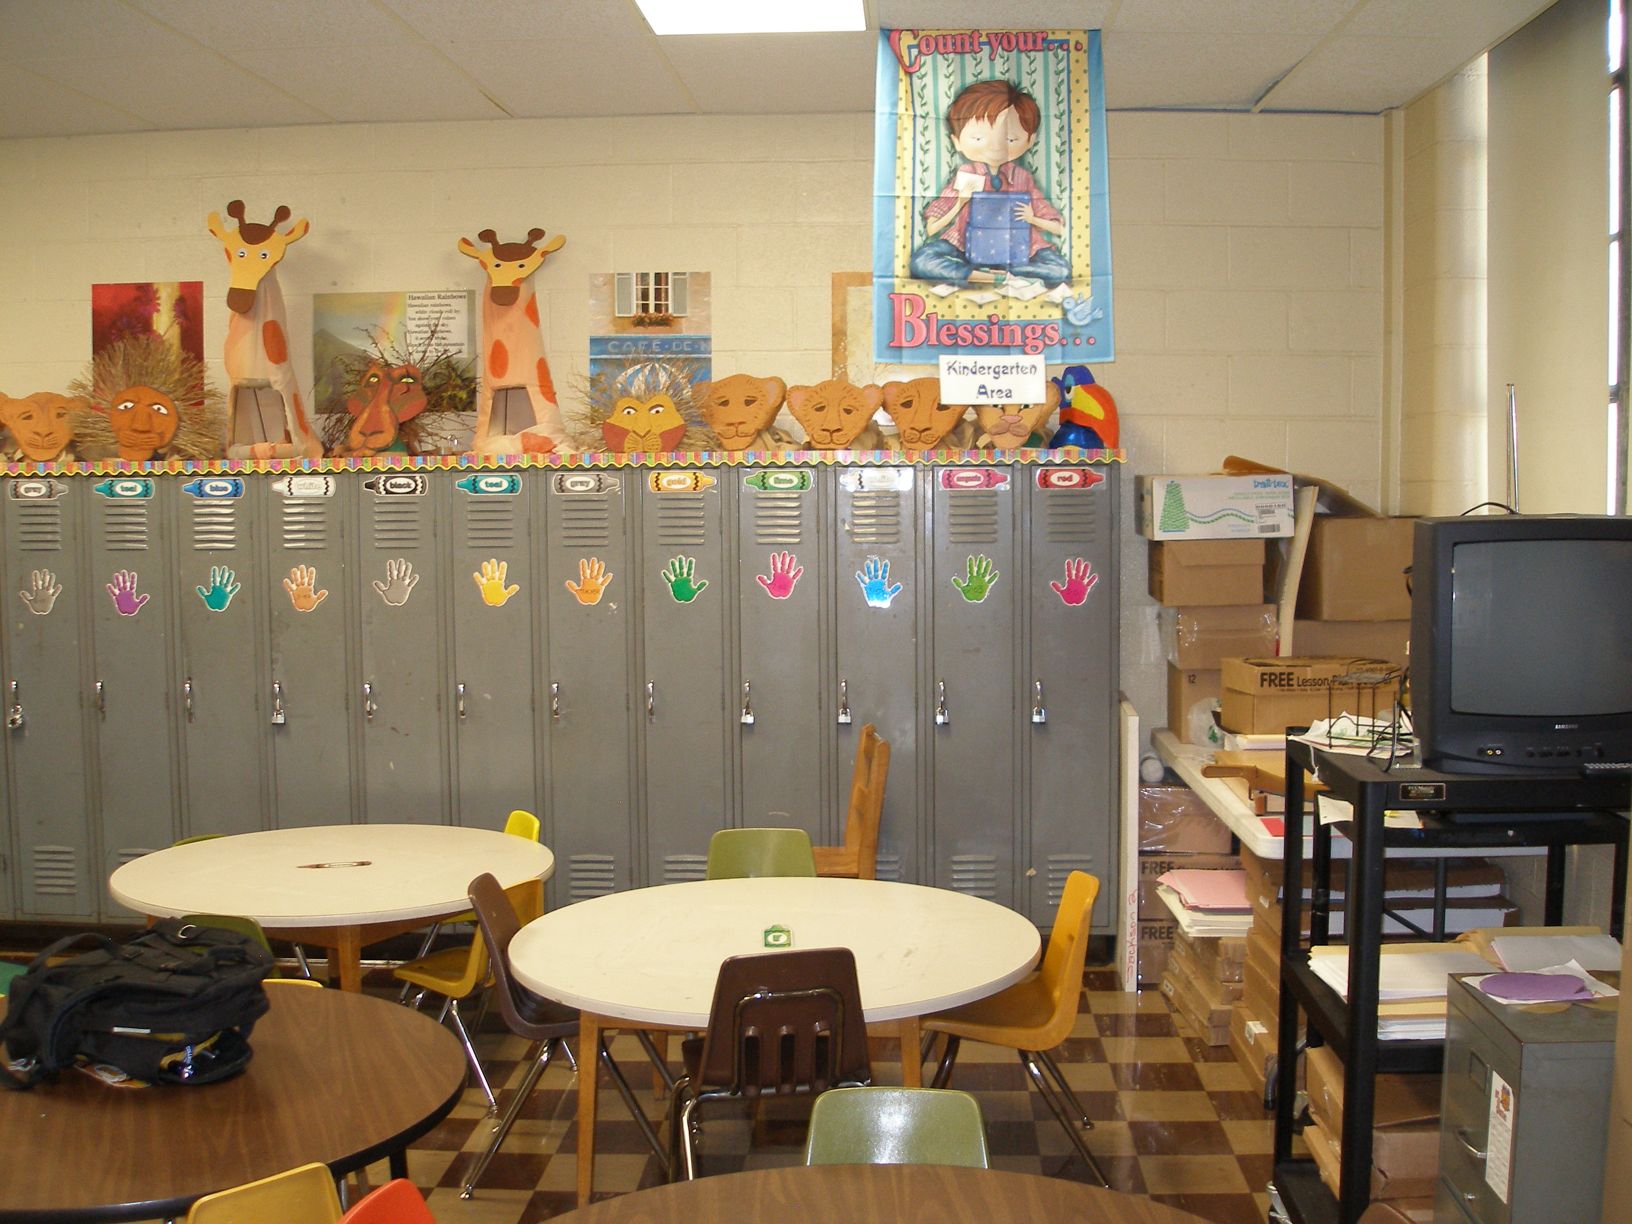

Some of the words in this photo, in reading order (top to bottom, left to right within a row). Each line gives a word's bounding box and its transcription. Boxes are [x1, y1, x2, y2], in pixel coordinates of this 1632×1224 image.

[888, 29, 982, 73] Count
[437, 293, 467, 301] Rainbows
[946, 360, 1038, 379] Kindergarten
[975, 384, 1013, 400] Area
[389, 480, 413, 489] black
[484, 480, 503, 488] teal
[570, 480, 590, 490] gray
[1056, 475, 1073, 483] red
[209, 484, 228, 492] blue
[1260, 672, 1294, 688] FREE
[1297, 676, 1331, 687] Lesson
[1141, 860, 1175, 875] FREE
[1141, 926, 1174, 940] FREE
